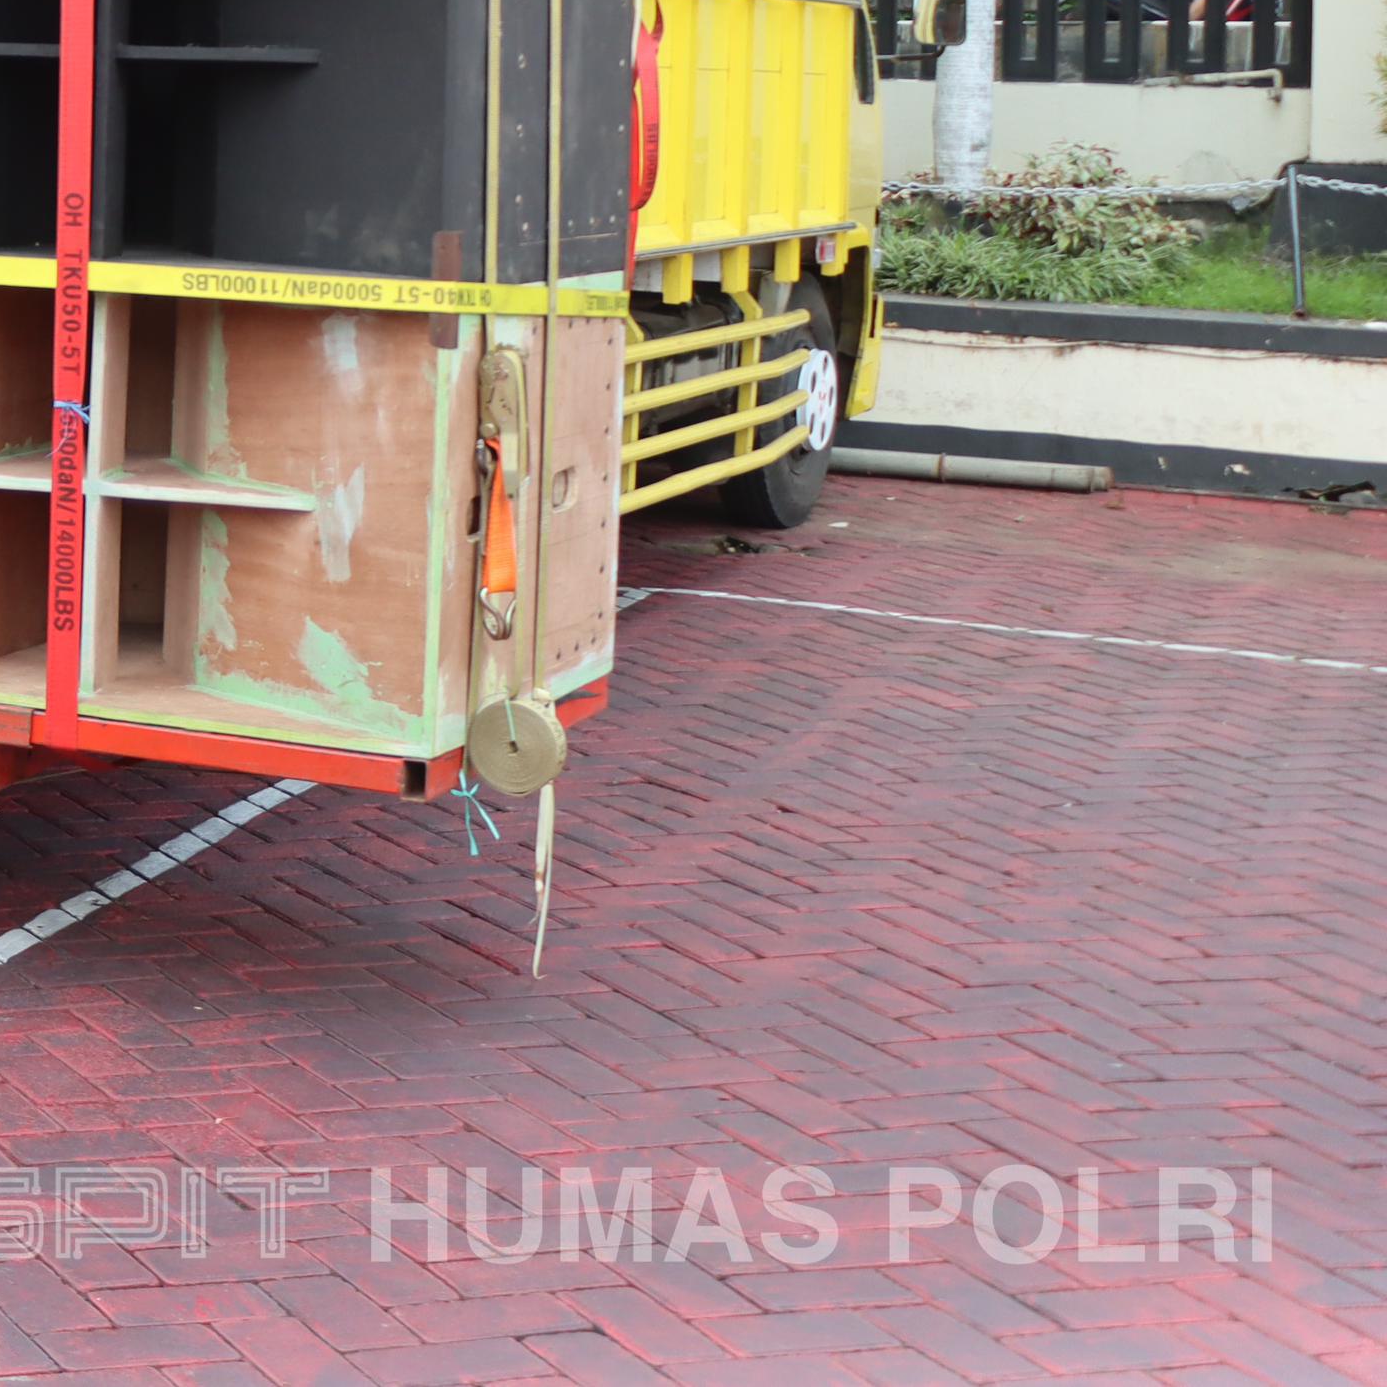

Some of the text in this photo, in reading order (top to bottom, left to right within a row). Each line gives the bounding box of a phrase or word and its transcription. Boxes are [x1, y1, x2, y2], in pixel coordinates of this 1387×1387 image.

[181, 272, 383, 303] 5000daN/11000LBS
[54, 192, 84, 631] OH TKU50-5T 500daN/14000LBS
